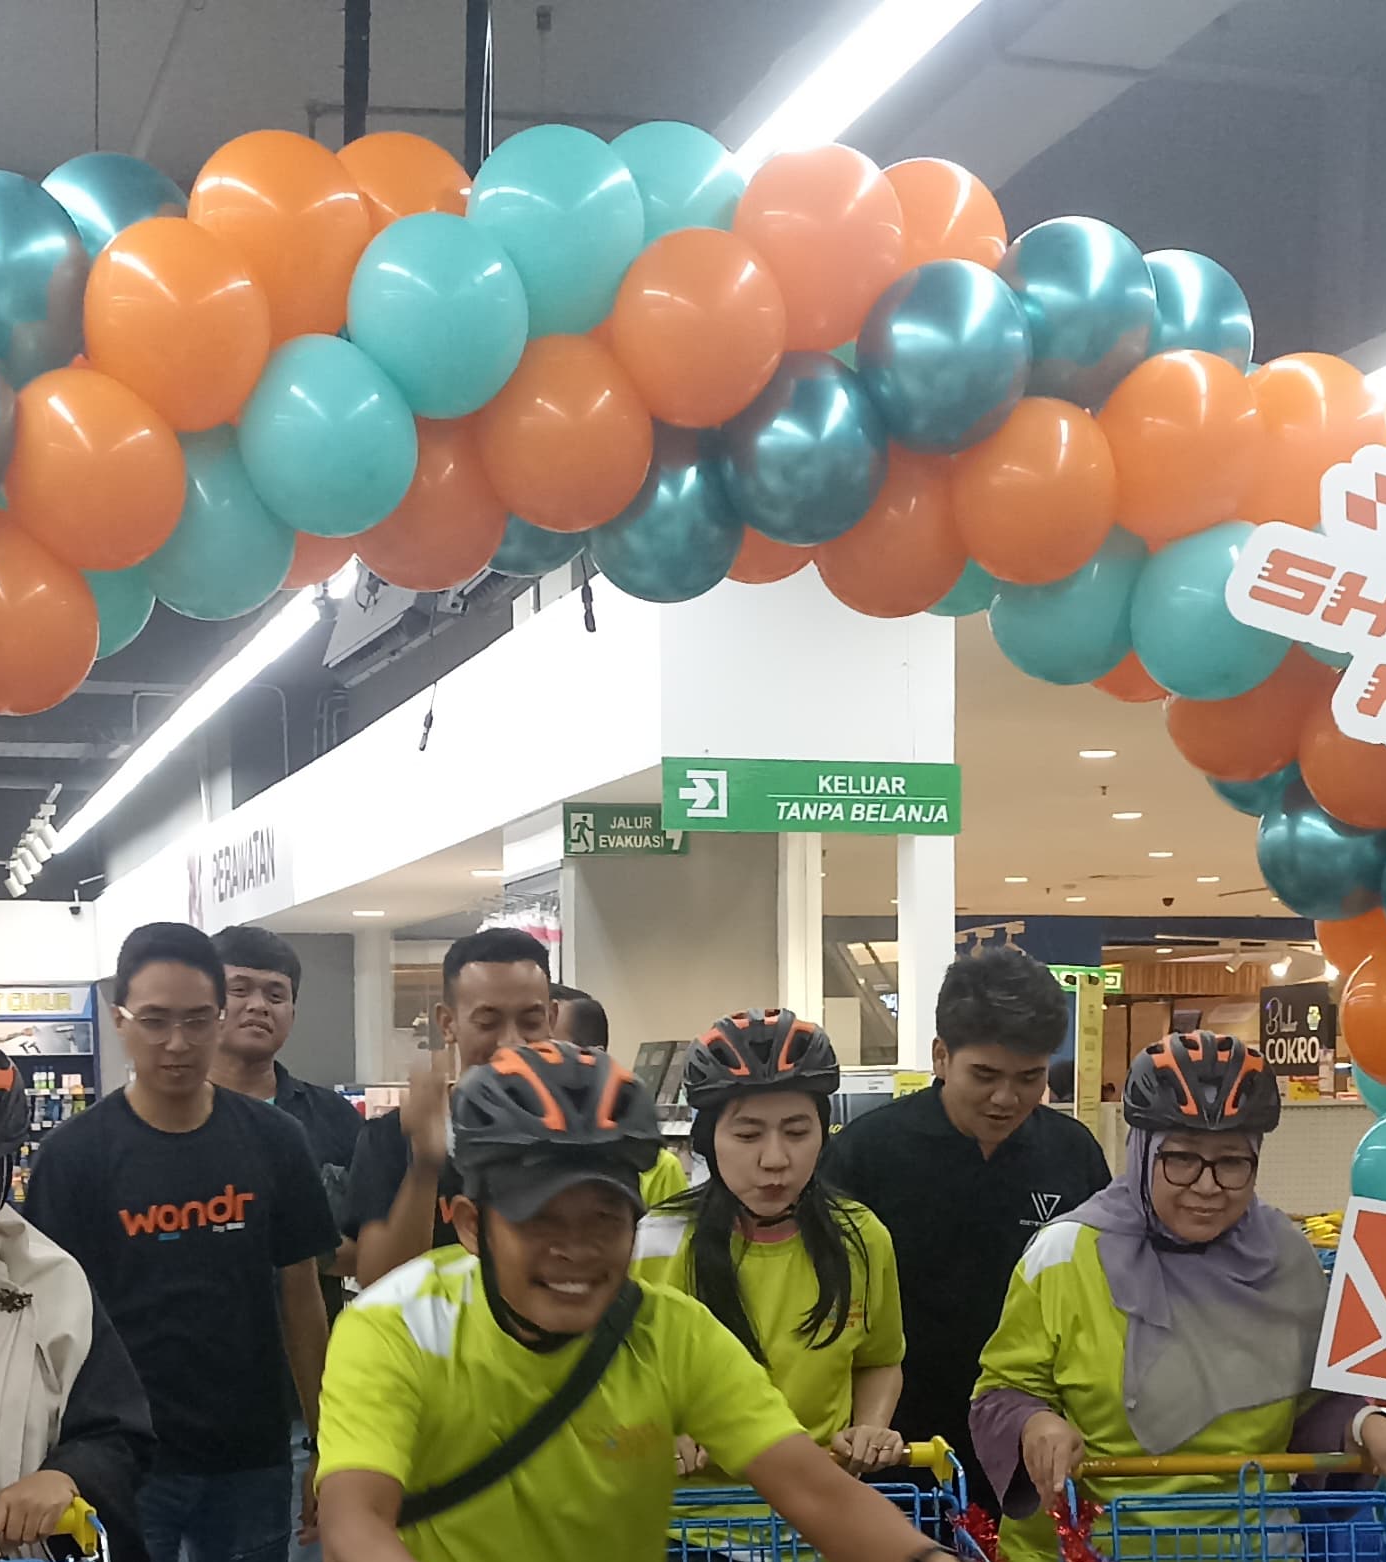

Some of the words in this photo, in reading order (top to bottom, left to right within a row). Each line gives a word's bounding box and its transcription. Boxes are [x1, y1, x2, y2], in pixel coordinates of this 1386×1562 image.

[817, 774, 907, 795] KELUAR
[775, 801, 846, 823] TANPA
[850, 803, 950, 823] BELANJA
[609, 816, 653, 831] JALUR
[598, 834, 665, 850] EVAKUASI
[1265, 1037, 1320, 1065] COKRO
[118, 1183, 256, 1237] wondr
